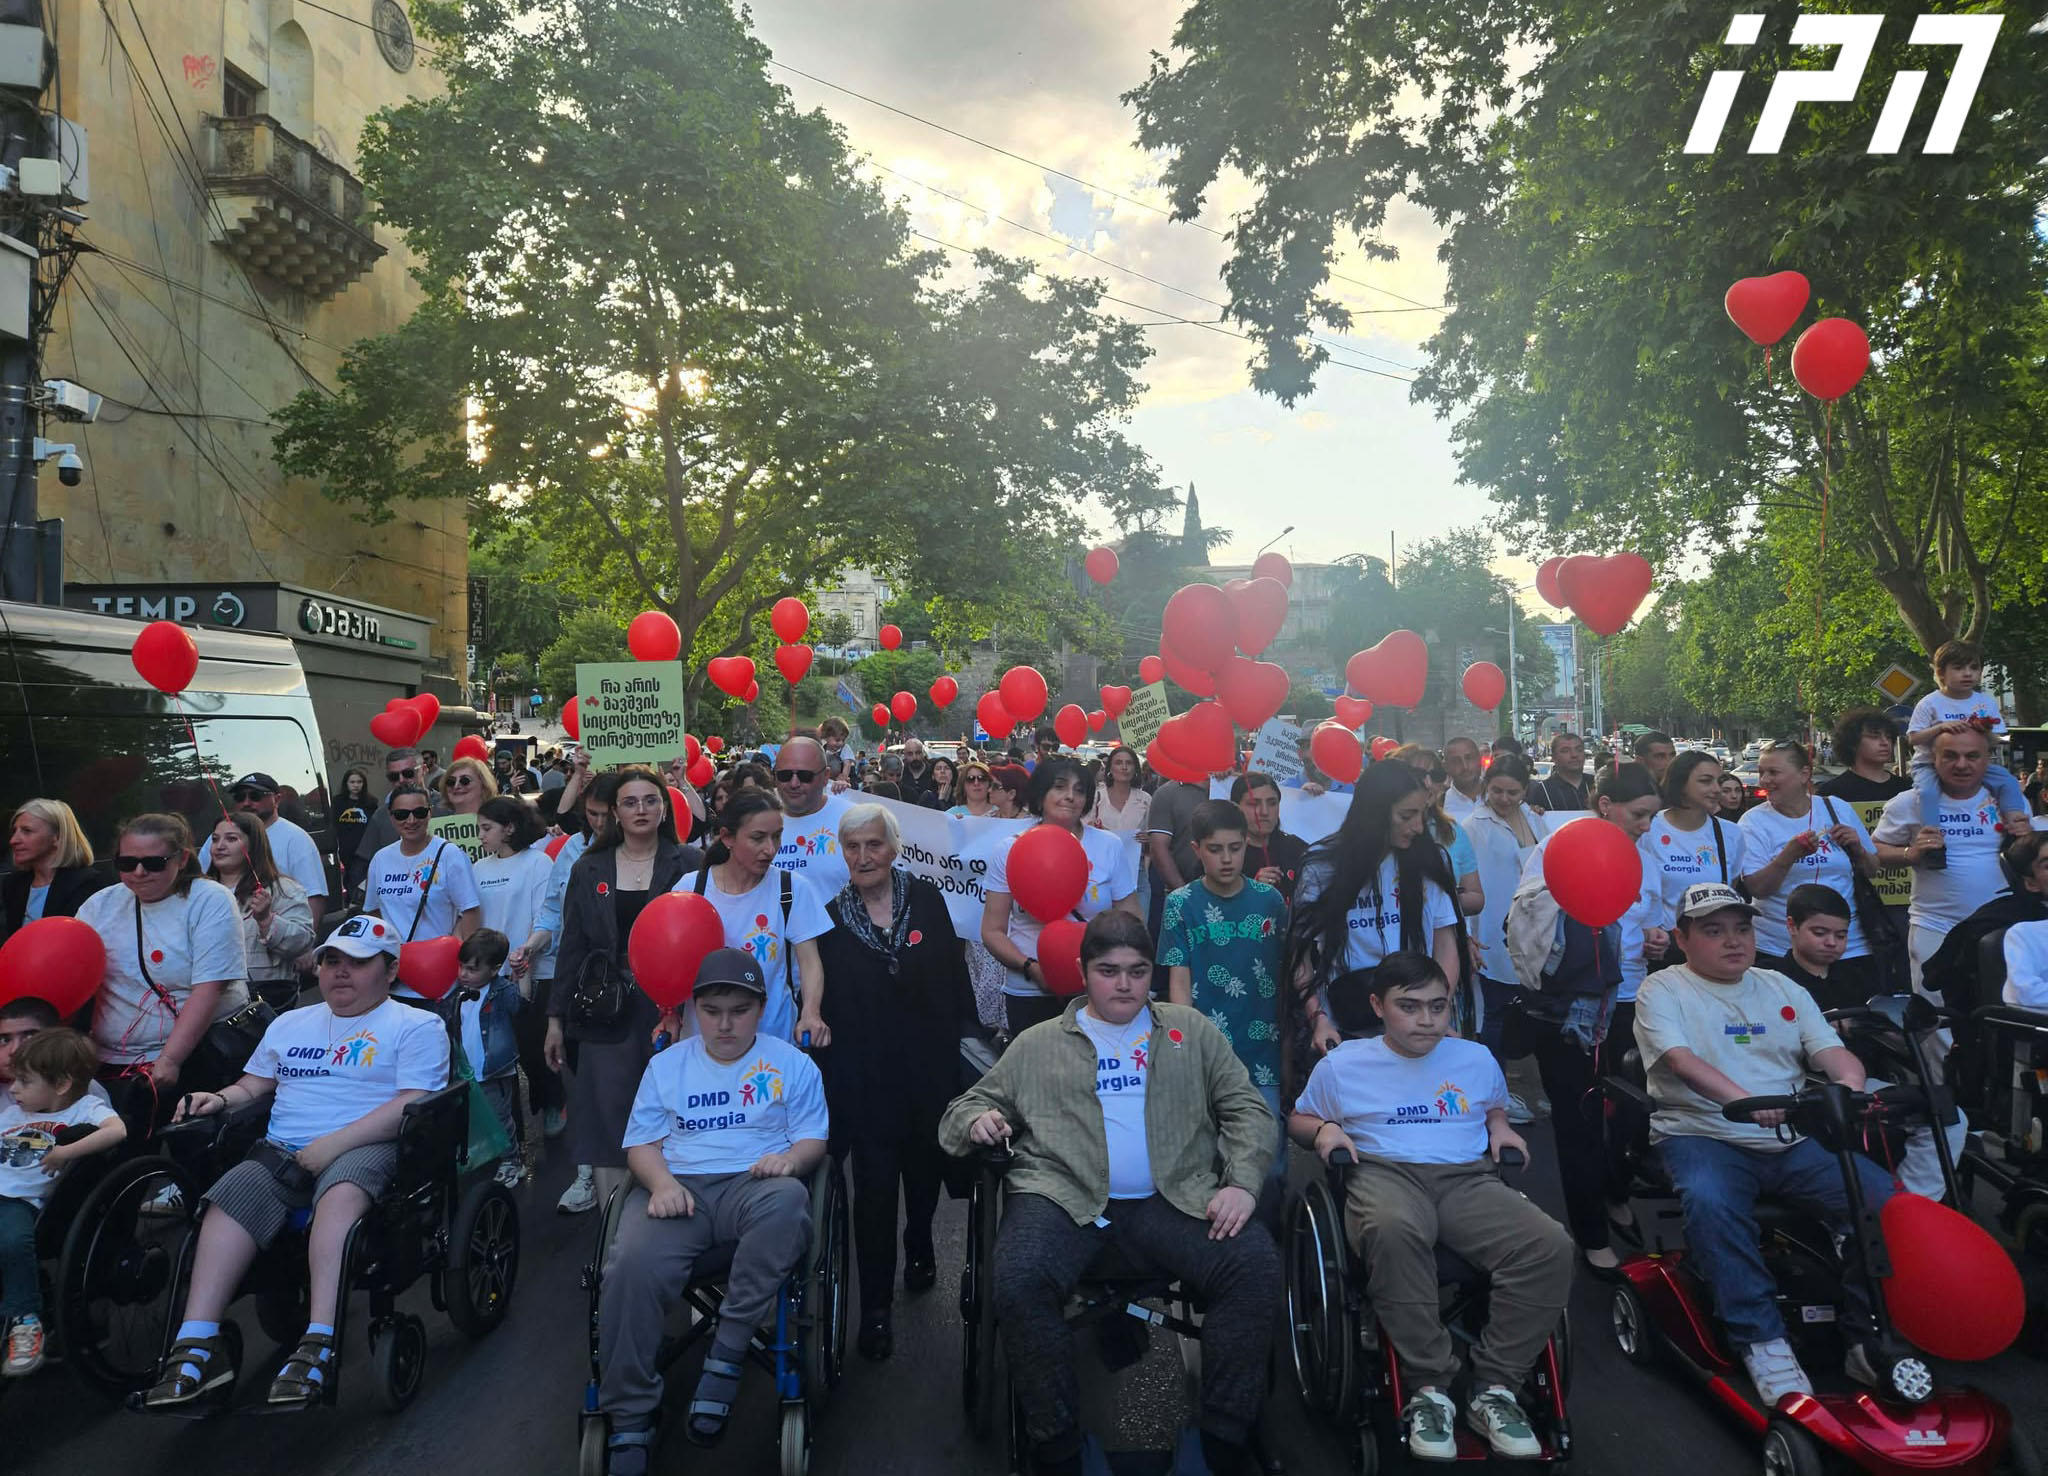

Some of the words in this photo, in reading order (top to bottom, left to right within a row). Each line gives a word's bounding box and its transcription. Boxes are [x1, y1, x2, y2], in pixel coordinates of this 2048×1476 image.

[600, 679, 621, 694] რა
[625, 677, 660, 693] არის
[603, 694, 659, 713] ბავშვის
[582, 710, 681, 731] სიცოცხლეზე
[587, 729, 679, 751] ღირებული?!
[1939, 813, 1972, 823] DMD
[1939, 826, 1984, 838] eorgia
[778, 844, 798, 855] MD
[1670, 854, 1692, 863] DMD
[1663, 864, 1701, 874] Georgia
[384, 873, 409, 883] DMD
[1348, 911, 1401, 929] eorgia
[286, 1046, 326, 1060] DMD
[687, 1090, 730, 1109] DMD
[1396, 1104, 1429, 1116] DMD
